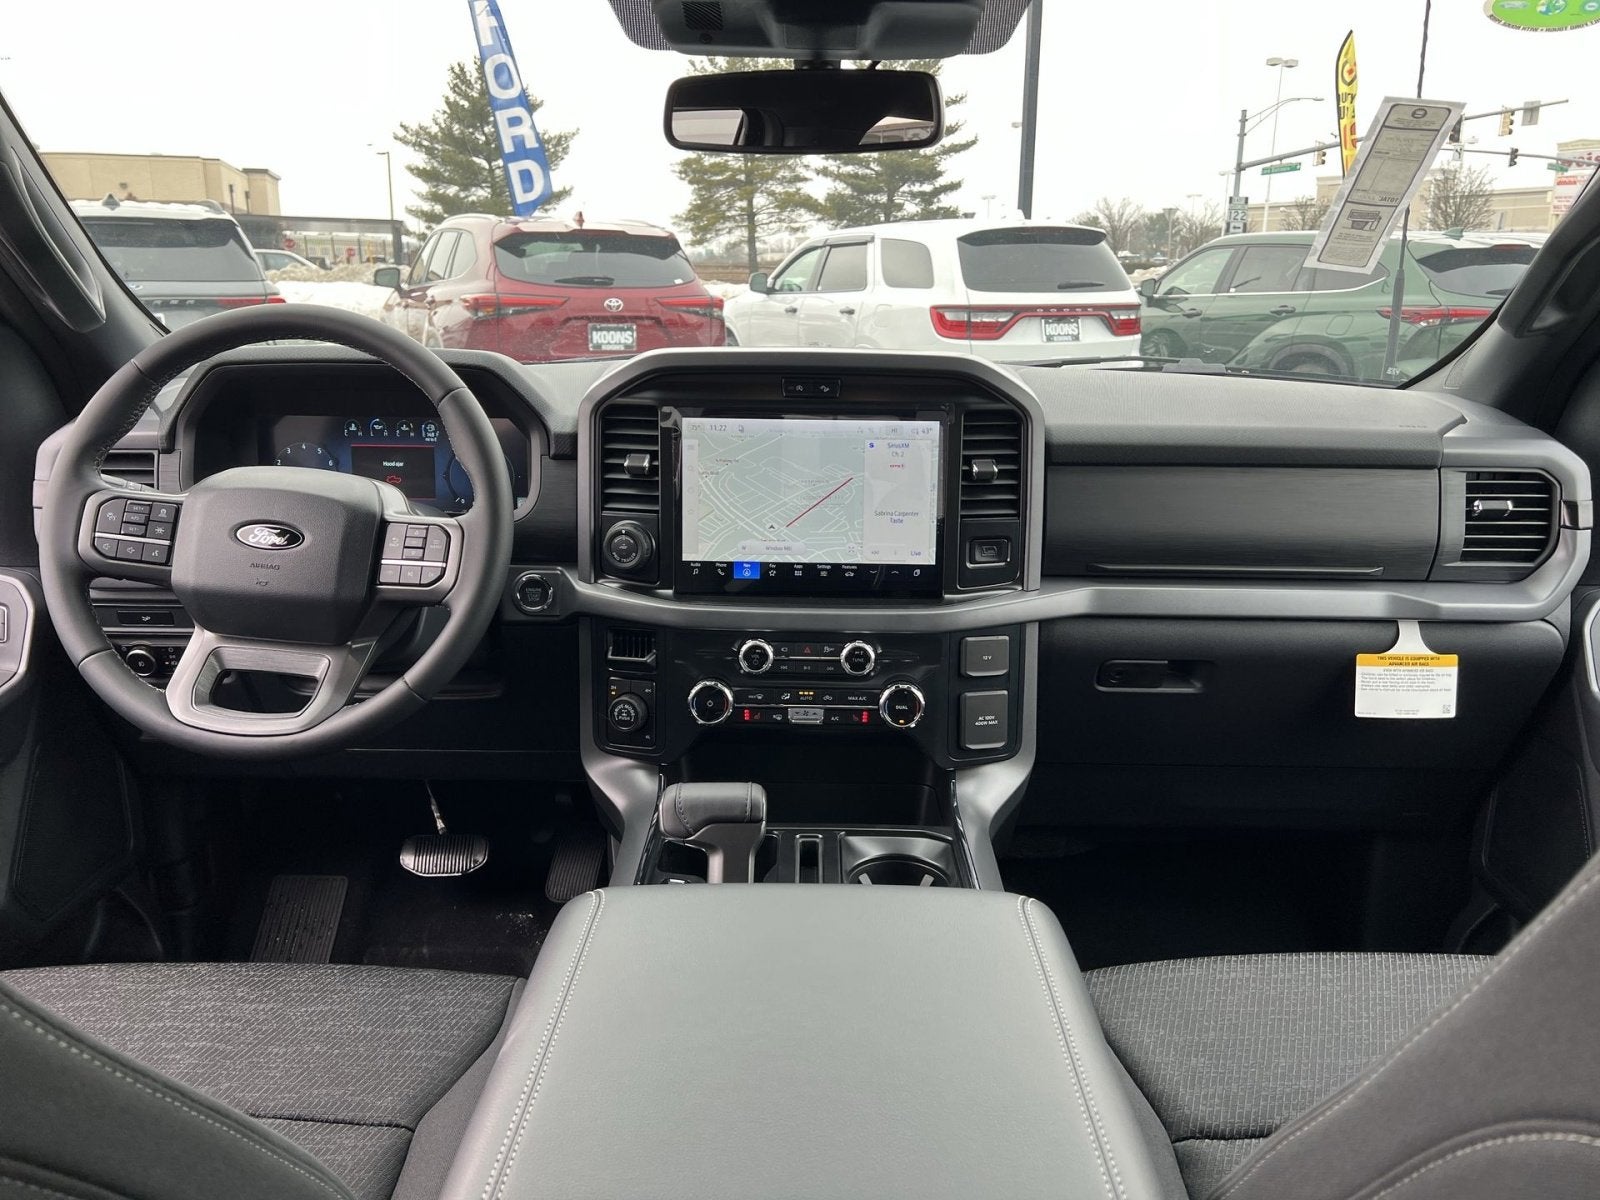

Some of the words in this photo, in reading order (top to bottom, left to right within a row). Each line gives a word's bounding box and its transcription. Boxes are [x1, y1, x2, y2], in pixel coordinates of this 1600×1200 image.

[474, 0, 545, 204] FORD
[1228, 210, 1247, 220] 122
[592, 330, 633, 344] KOONS
[1046, 324, 1078, 336] KOONS
[248, 526, 290, 546] Ford
